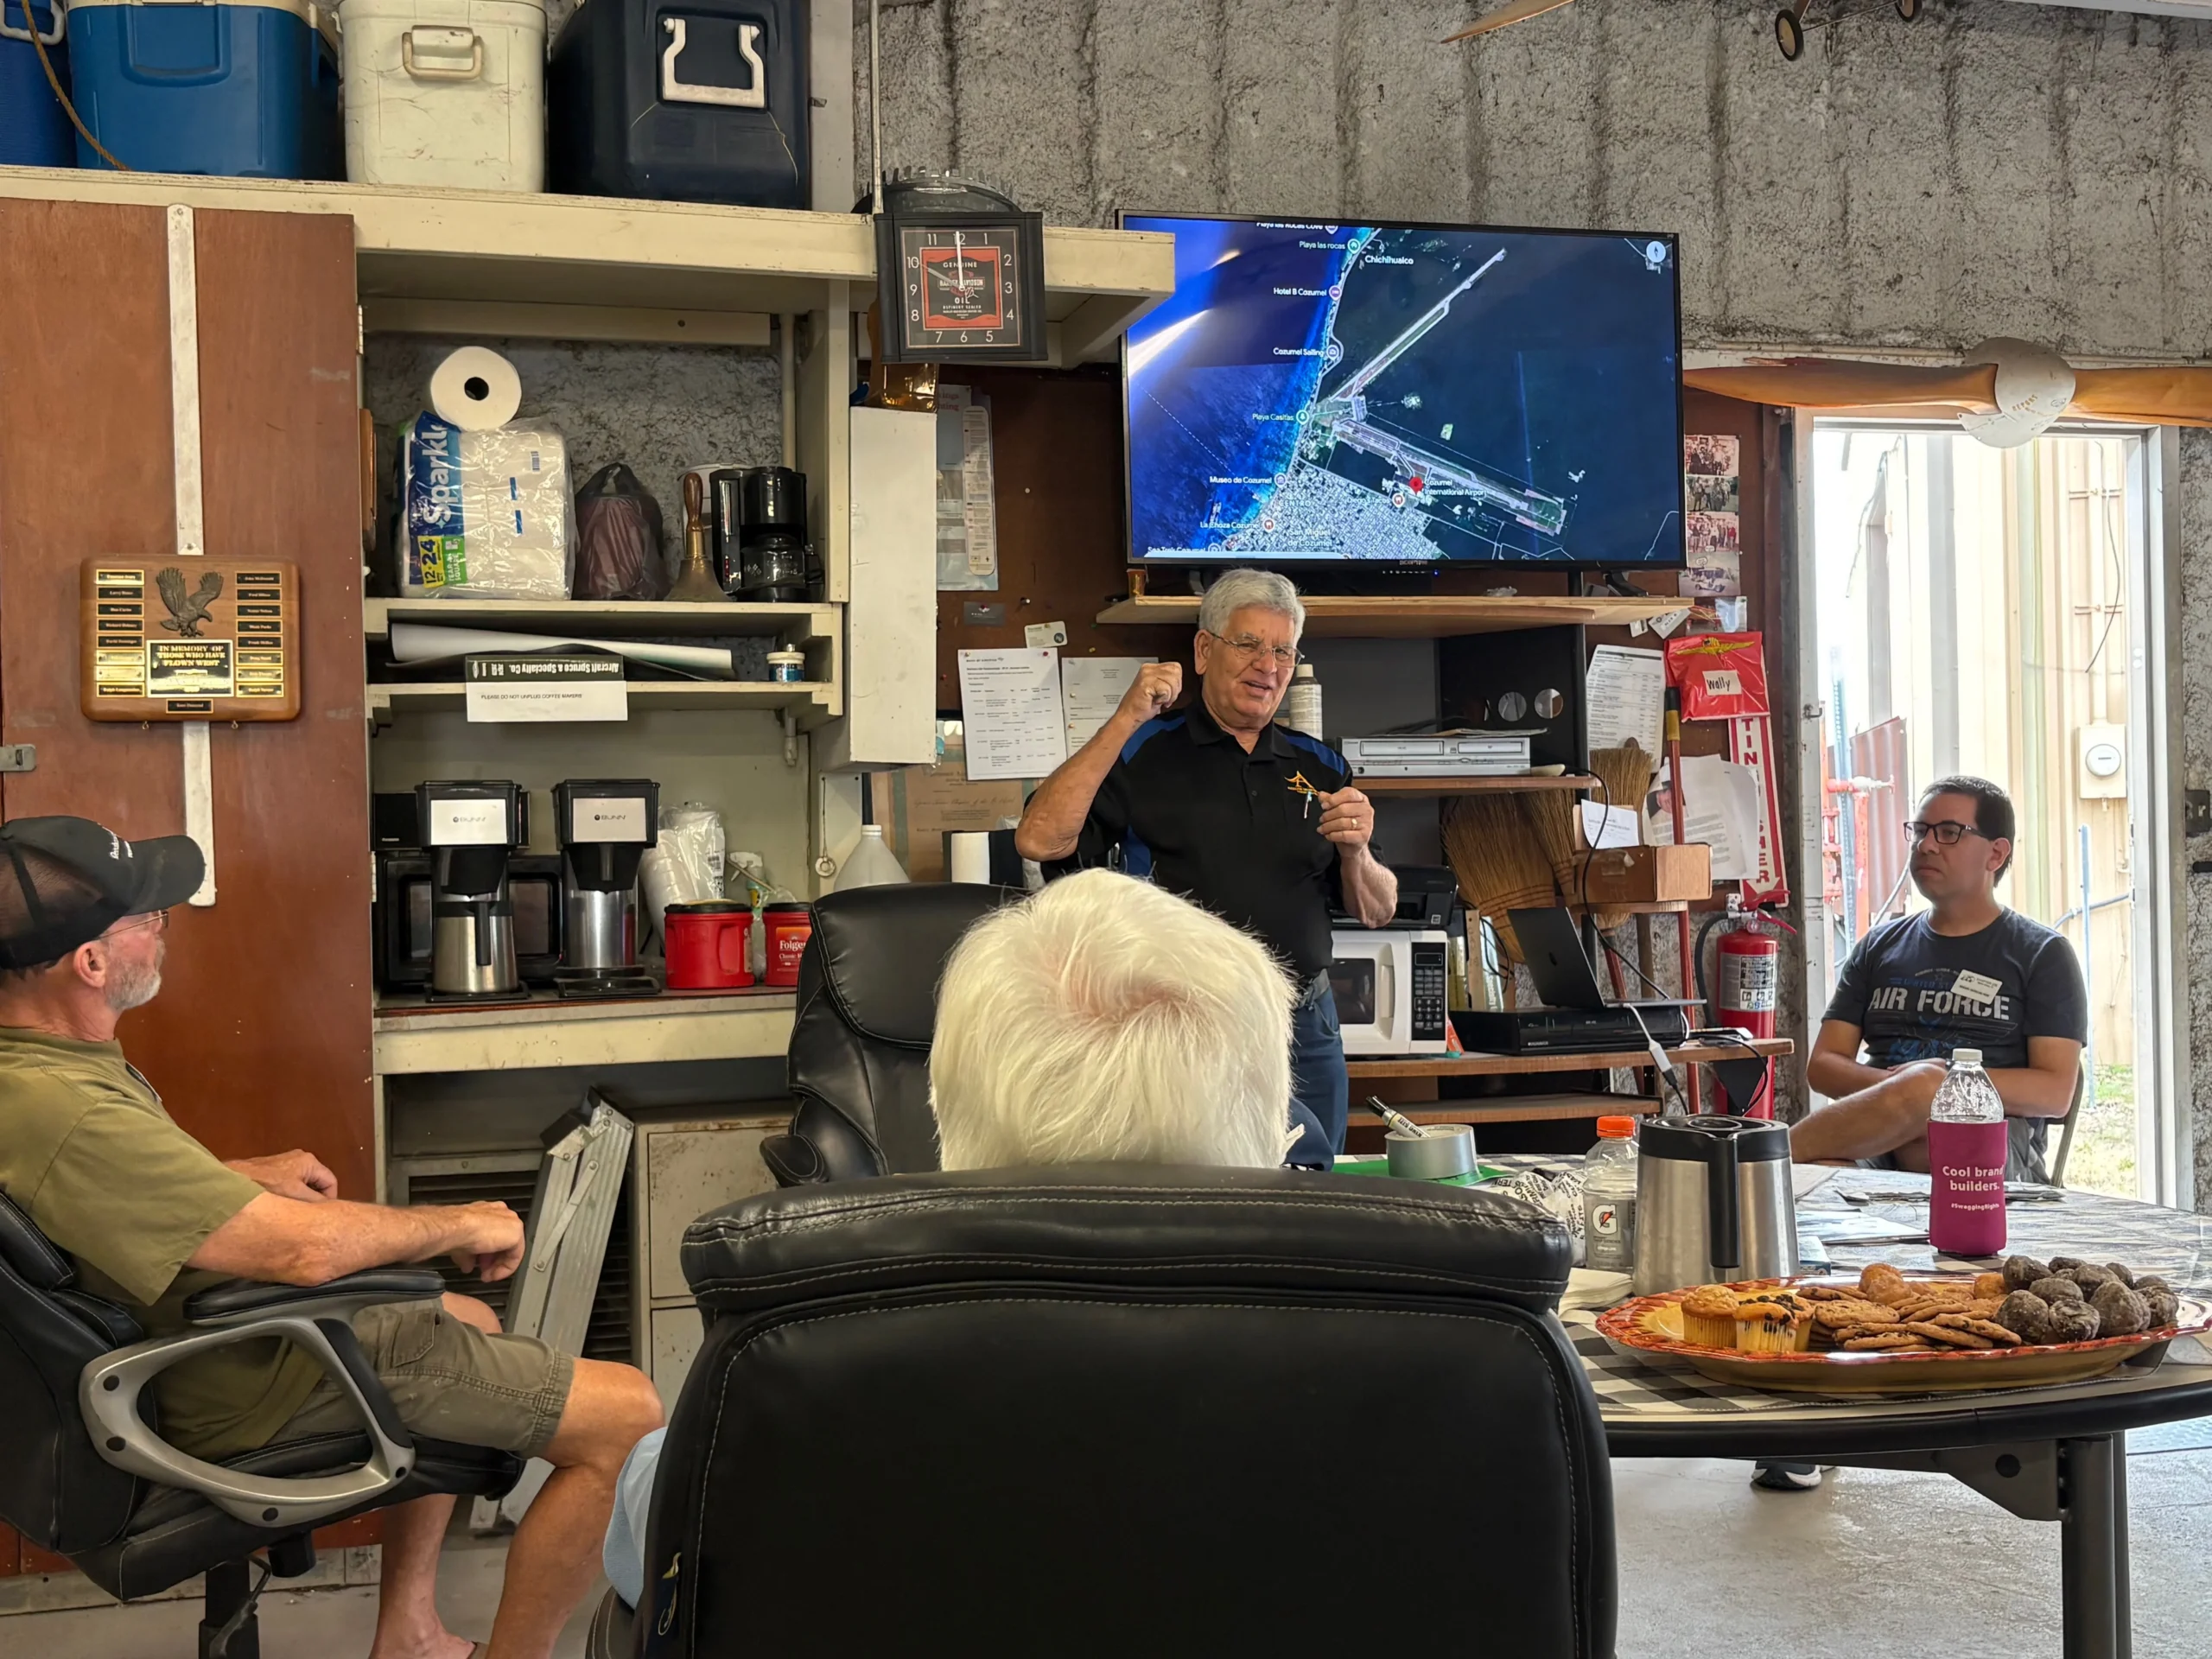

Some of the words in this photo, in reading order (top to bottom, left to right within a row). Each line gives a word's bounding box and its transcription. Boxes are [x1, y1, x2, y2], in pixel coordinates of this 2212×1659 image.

[927, 233, 938, 245] 11
[984, 233, 988, 245] 1
[1300, 241, 1317, 250] Playa
[907, 257, 919, 269] 10
[1004, 254, 1012, 266] 2
[1364, 255, 1414, 265] Chichihualco
[910, 284, 918, 296] 9
[1005, 282, 1013, 294] 3
[911, 310, 918, 321] 8
[1006, 308, 1014, 321] 4
[935, 331, 943, 343] 7
[960, 331, 968, 342] 6
[986, 330, 994, 342] 5
[1303, 348, 1325, 357] Sailing
[421, 539, 438, 565] 24
[424, 570, 436, 583] 12
[508, 664, 521, 674] Co.
[521, 663, 556, 674] Specialty
[564, 662, 590, 673] Spruce
[592, 662, 620, 674] Aircraft
[1707, 677, 1731, 691] Wally
[779, 939, 806, 951] Folger
[1867, 987, 1908, 1011] AIR
[1916, 990, 2010, 1020] FORCE
[1942, 1166, 1970, 1177] Cool
[1974, 1165, 2005, 1177] brand
[1949, 1179, 2000, 1192] builders.
[1592, 1205, 1618, 1235] G
